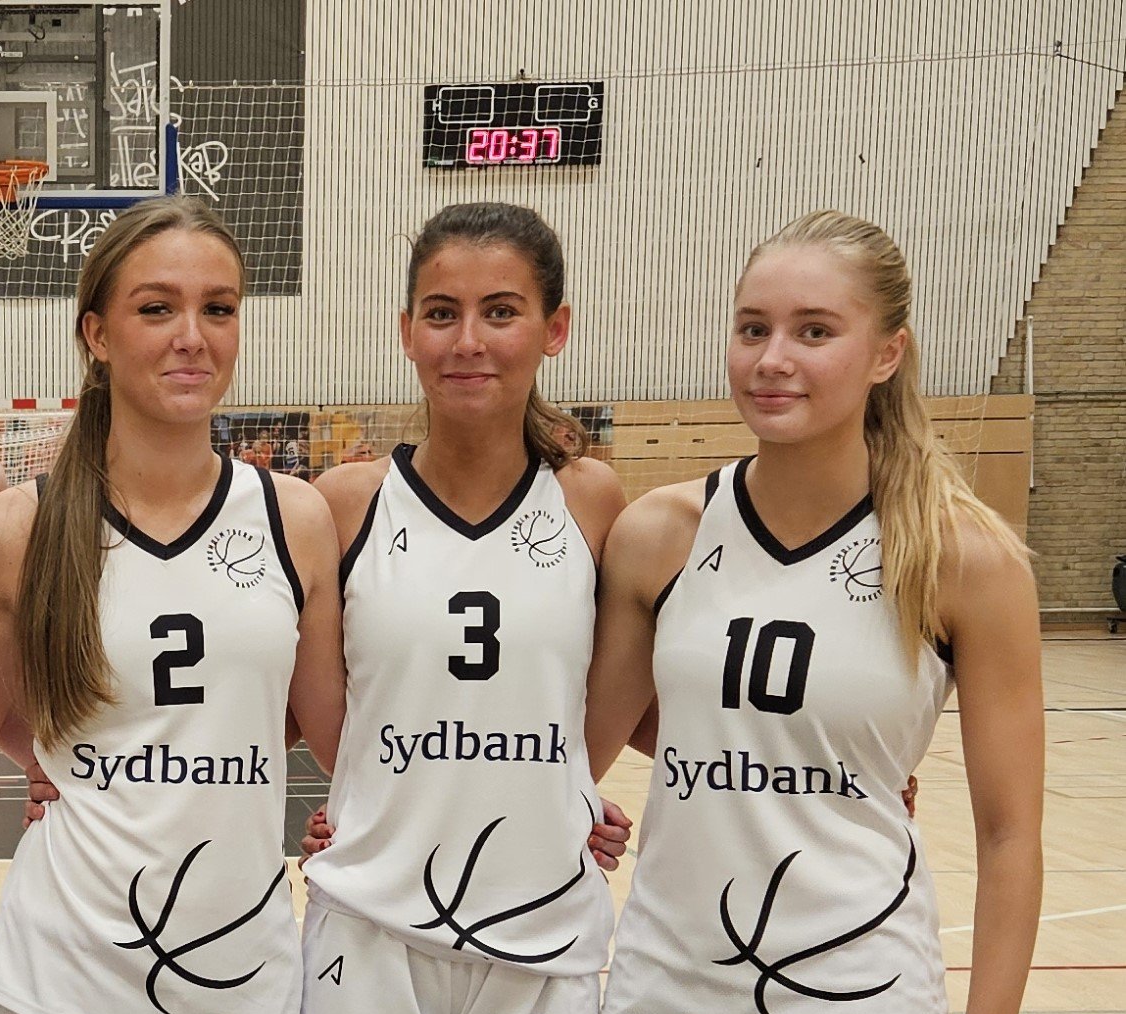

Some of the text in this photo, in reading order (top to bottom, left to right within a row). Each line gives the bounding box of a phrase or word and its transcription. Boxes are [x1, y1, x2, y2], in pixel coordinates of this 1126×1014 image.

[588, 97, 599, 109] G
[468, 130, 558, 160] 20:37
[150, 613, 205, 706] 2
[448, 591, 500, 680] 3
[722, 617, 816, 715] 10
[71, 743, 270, 790] Sydbank
[379, 720, 567, 774] Sydbank
[664, 746, 868, 800] Sydbank
